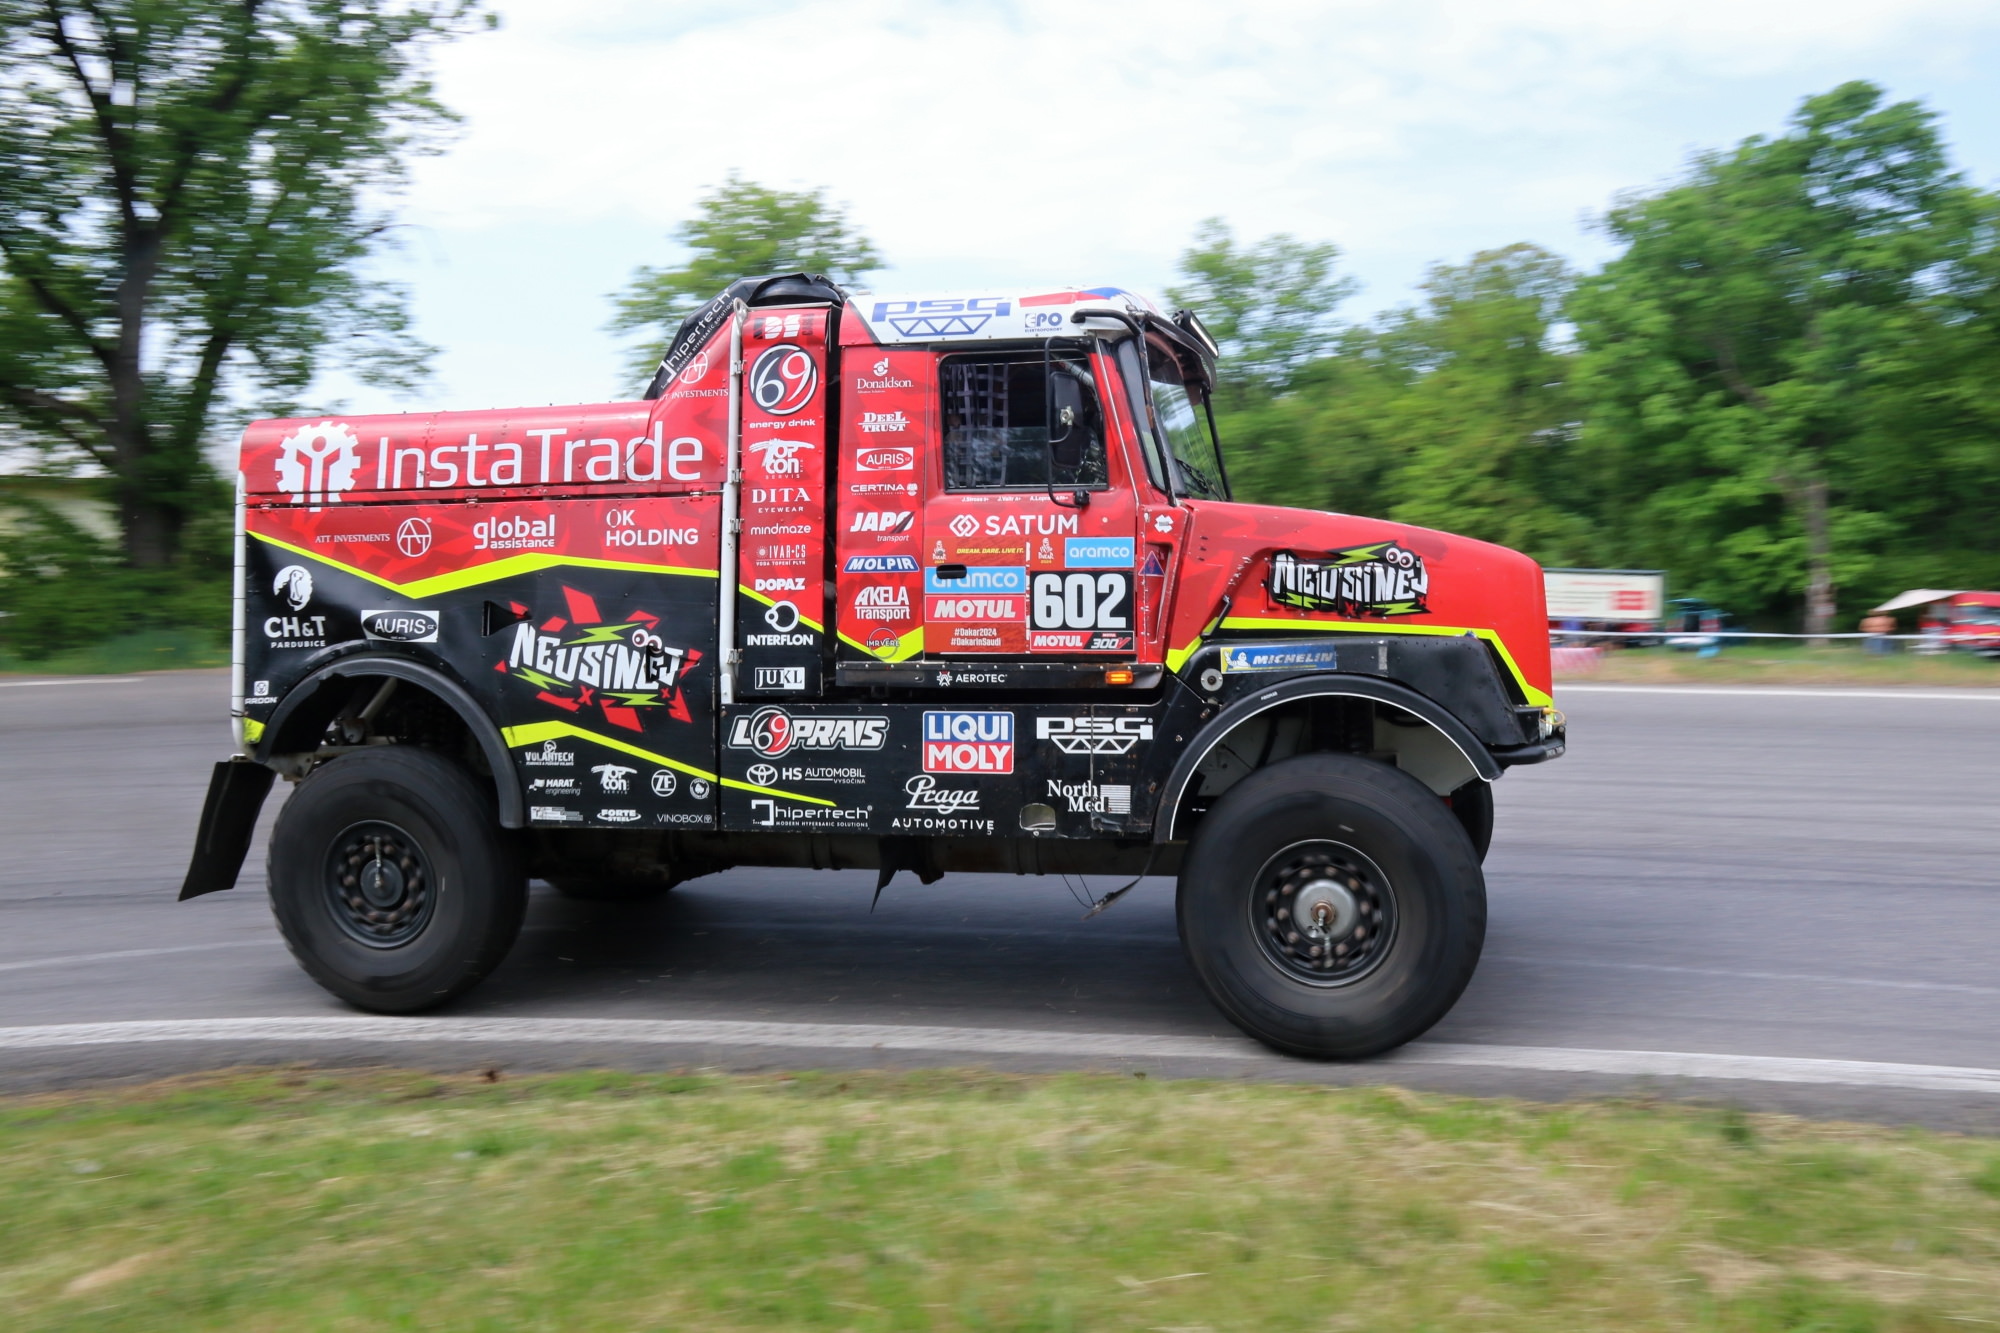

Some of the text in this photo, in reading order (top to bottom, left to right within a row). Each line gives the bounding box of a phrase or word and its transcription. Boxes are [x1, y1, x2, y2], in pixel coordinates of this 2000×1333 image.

[666, 288, 730, 367] hipertech
[755, 351, 812, 408] 69
[672, 389, 729, 399] INVESTMENTS
[750, 419, 816, 429] energy drink
[862, 424, 906, 432] TRUST
[377, 421, 703, 489] InstaTrade
[866, 453, 904, 465] AURIS
[850, 483, 905, 492] CERTINA
[751, 488, 811, 503] DITA
[606, 509, 635, 528] OK
[985, 515, 1078, 535] SATUM
[473, 514, 555, 549] global
[751, 523, 811, 535] mindmaze
[334, 534, 390, 543] INVESTMENTS
[490, 538, 555, 549] assistance
[606, 528, 699, 546] HOLDING
[877, 534, 909, 542] transport
[1069, 546, 1130, 558] aramco
[848, 557, 915, 570] MOLPIR
[755, 578, 806, 591] DOPAZ
[854, 586, 910, 605] AKELA
[1033, 573, 1127, 629] 602
[854, 606, 911, 622] Transport
[934, 599, 1016, 618] MOTUL
[263, 616, 326, 638] CH&T
[374, 618, 426, 634] AURIS
[954, 628, 997, 637] #Dakar2024
[270, 640, 326, 649] PARDUBICE
[747, 634, 814, 646] INTERFLON
[1033, 635, 1083, 647] MOTUL
[1091, 637, 1131, 649] 300V
[1253, 652, 1333, 665] MICHELIN
[757, 669, 803, 688] JUKL
[955, 674, 1005, 684] AEROTEC
[928, 715, 1009, 742] LIQUI
[525, 752, 574, 762] VOLANTECH
[928, 744, 1011, 770] MOLY
[782, 768, 866, 780] HS AUTOMOBIL
[545, 779, 575, 787] MARAT
[654, 774, 674, 792] ZF
[1047, 779, 1098, 797] North
[545, 788, 581, 796] engineering
[906, 774, 980, 815] Praga
[1068, 797, 1105, 813] Med
[601, 809, 637, 817] FORTE
[657, 814, 704, 823] VINOBOX
[775, 806, 869, 820] hipertech
[892, 818, 994, 830] AUTOMOTIVE
